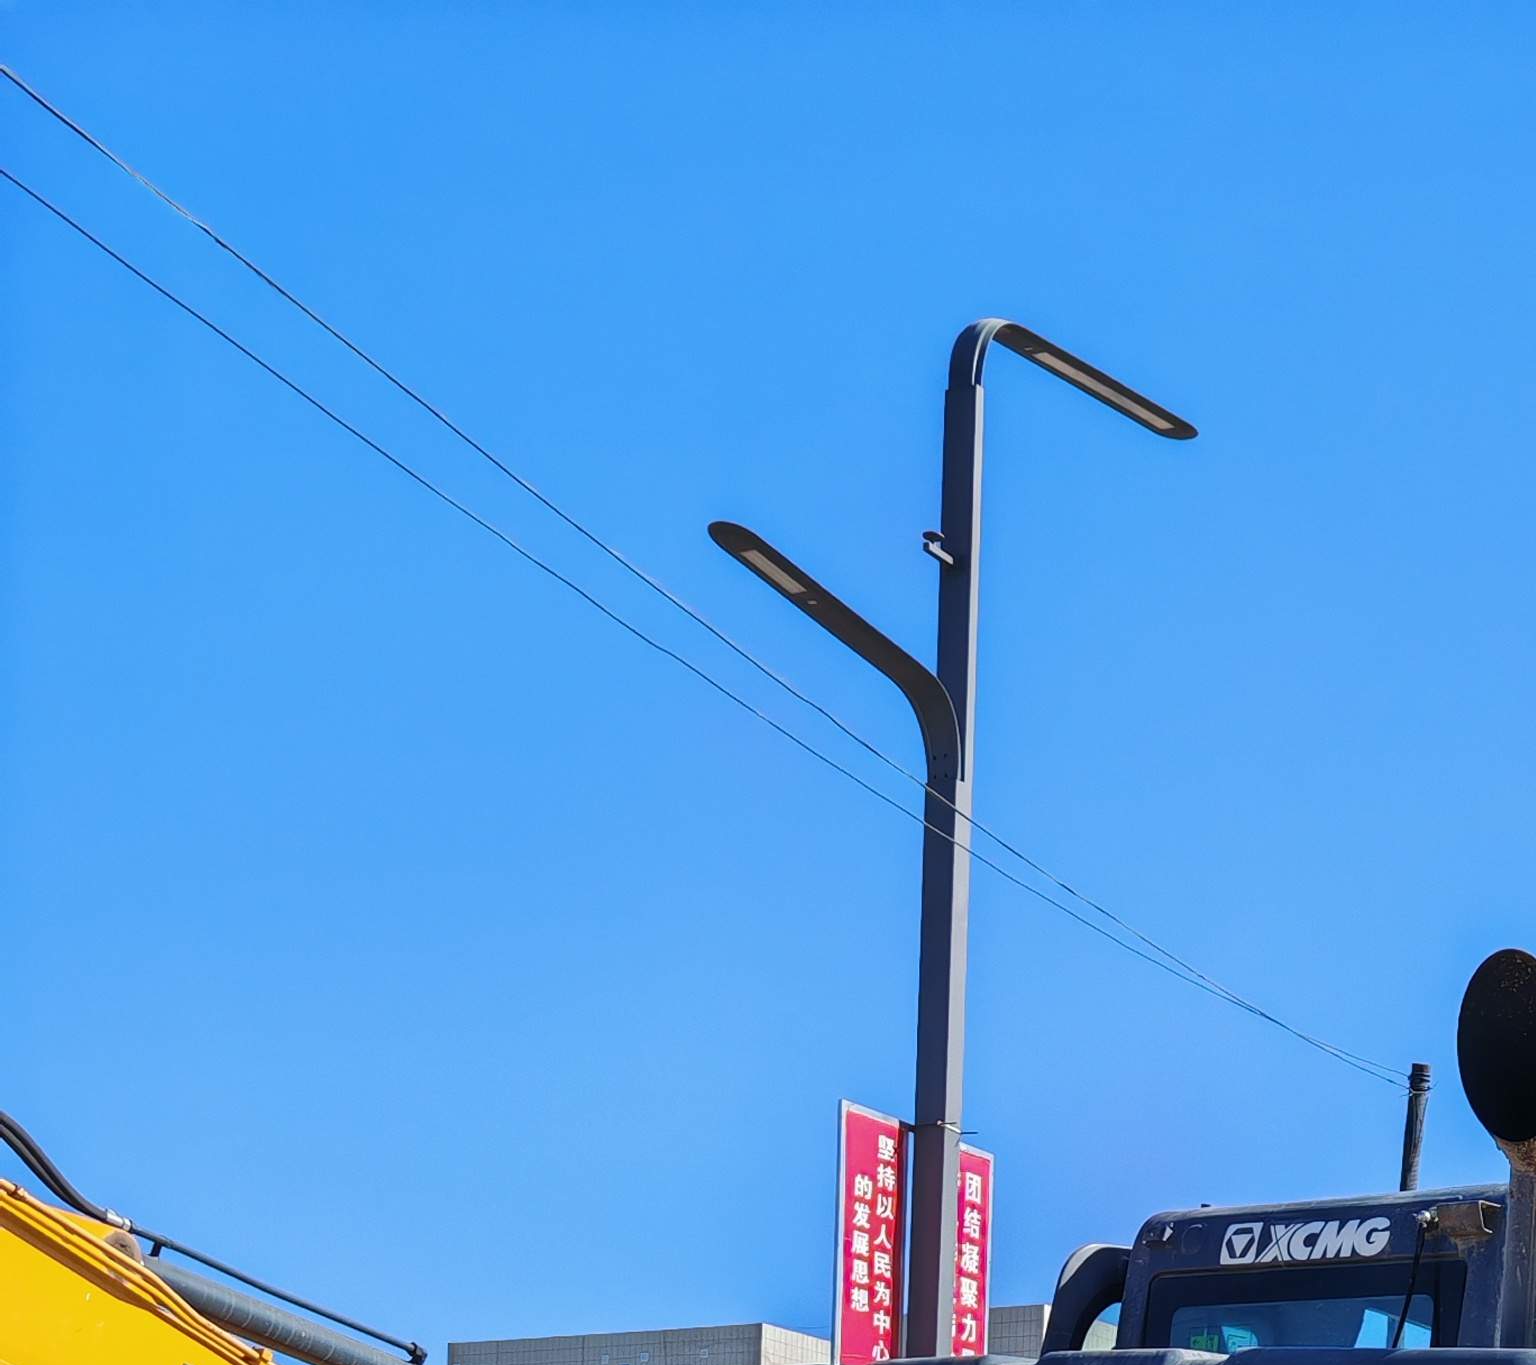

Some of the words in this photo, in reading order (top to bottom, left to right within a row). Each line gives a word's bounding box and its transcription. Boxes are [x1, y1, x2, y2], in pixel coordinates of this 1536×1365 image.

[851, 1173, 873, 1313] 的发展思想
[872, 1135, 897, 1362] 坚持以人民为中心
[1255, 1216, 1391, 1264] XCMG
